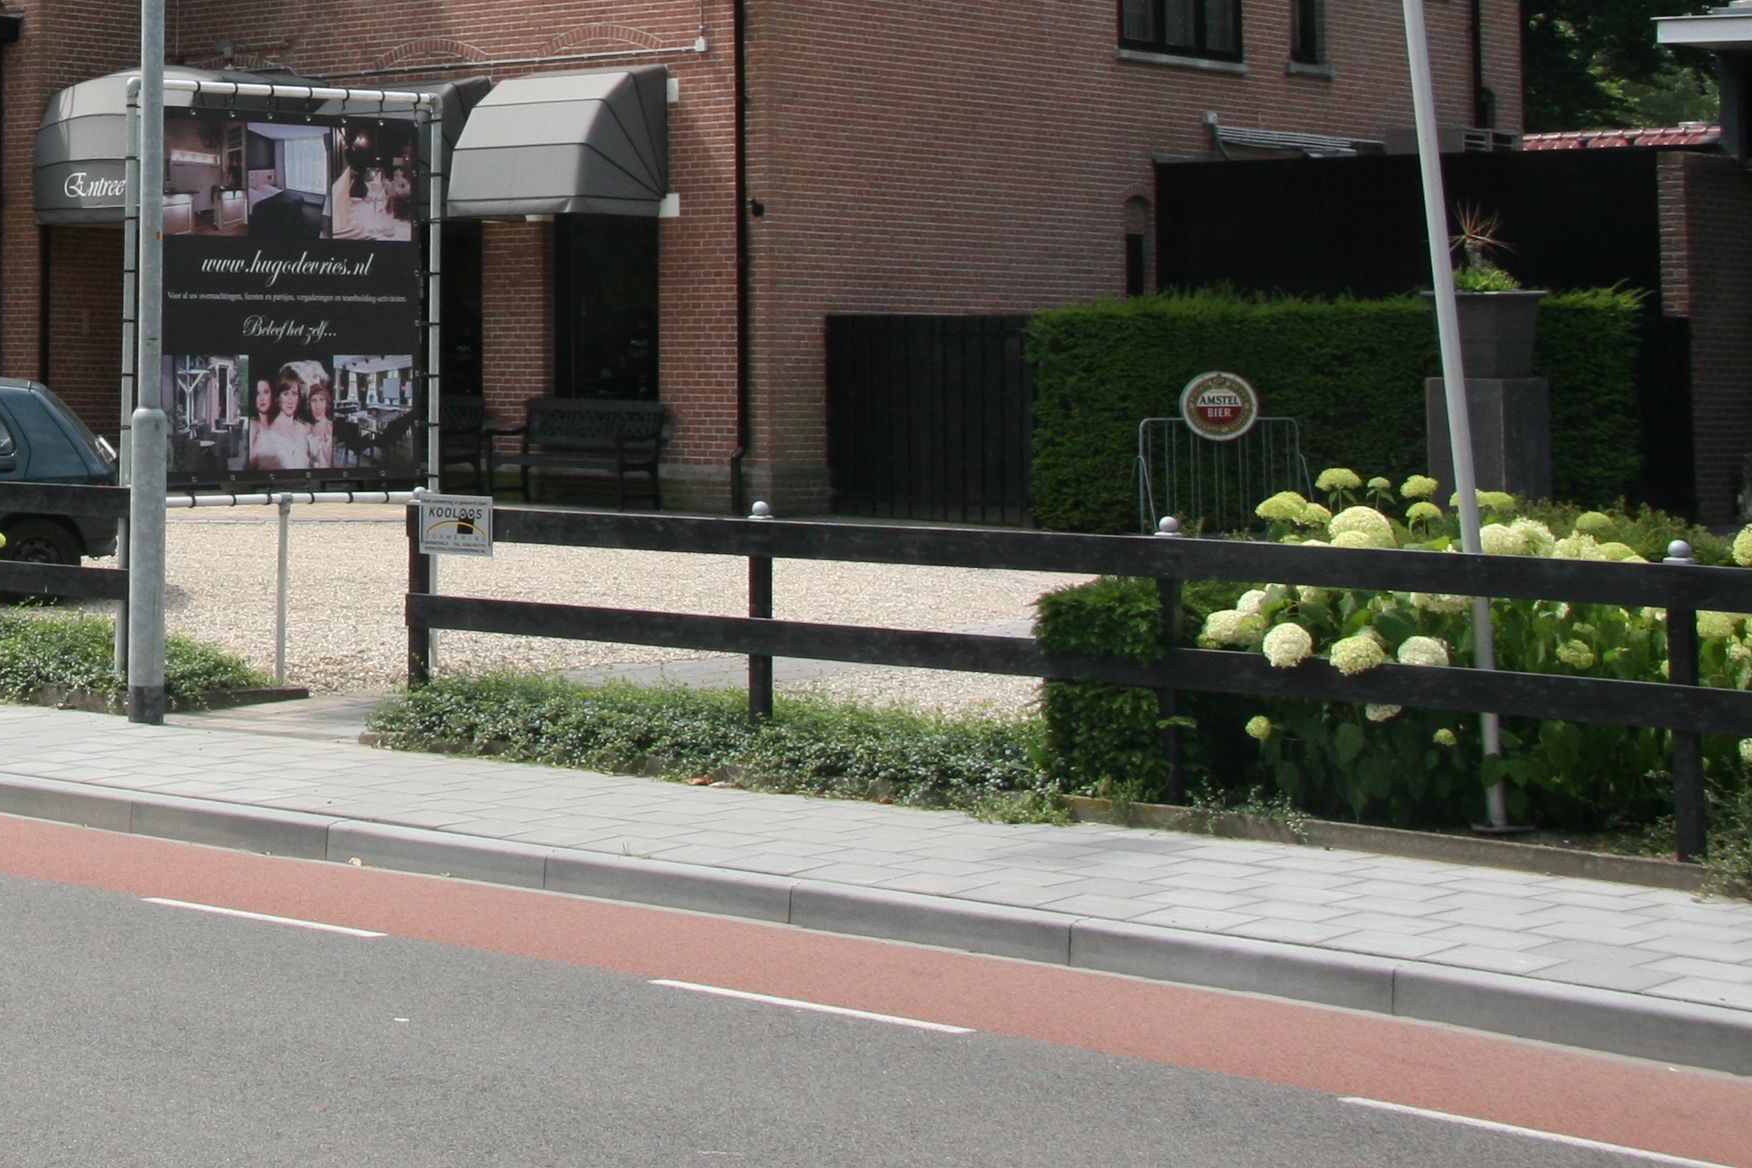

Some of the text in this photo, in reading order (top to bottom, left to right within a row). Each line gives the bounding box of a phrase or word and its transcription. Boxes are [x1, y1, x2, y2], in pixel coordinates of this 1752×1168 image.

[64, 172, 129, 198] Entree
[201, 249, 375, 288] www.hugodevries.nl
[242, 314, 289, 343] Beleef
[286, 320, 305, 337] het
[1199, 395, 1239, 405] AMSTEL
[1207, 407, 1231, 417] BIER
[428, 506, 483, 520] KOOLOOS
